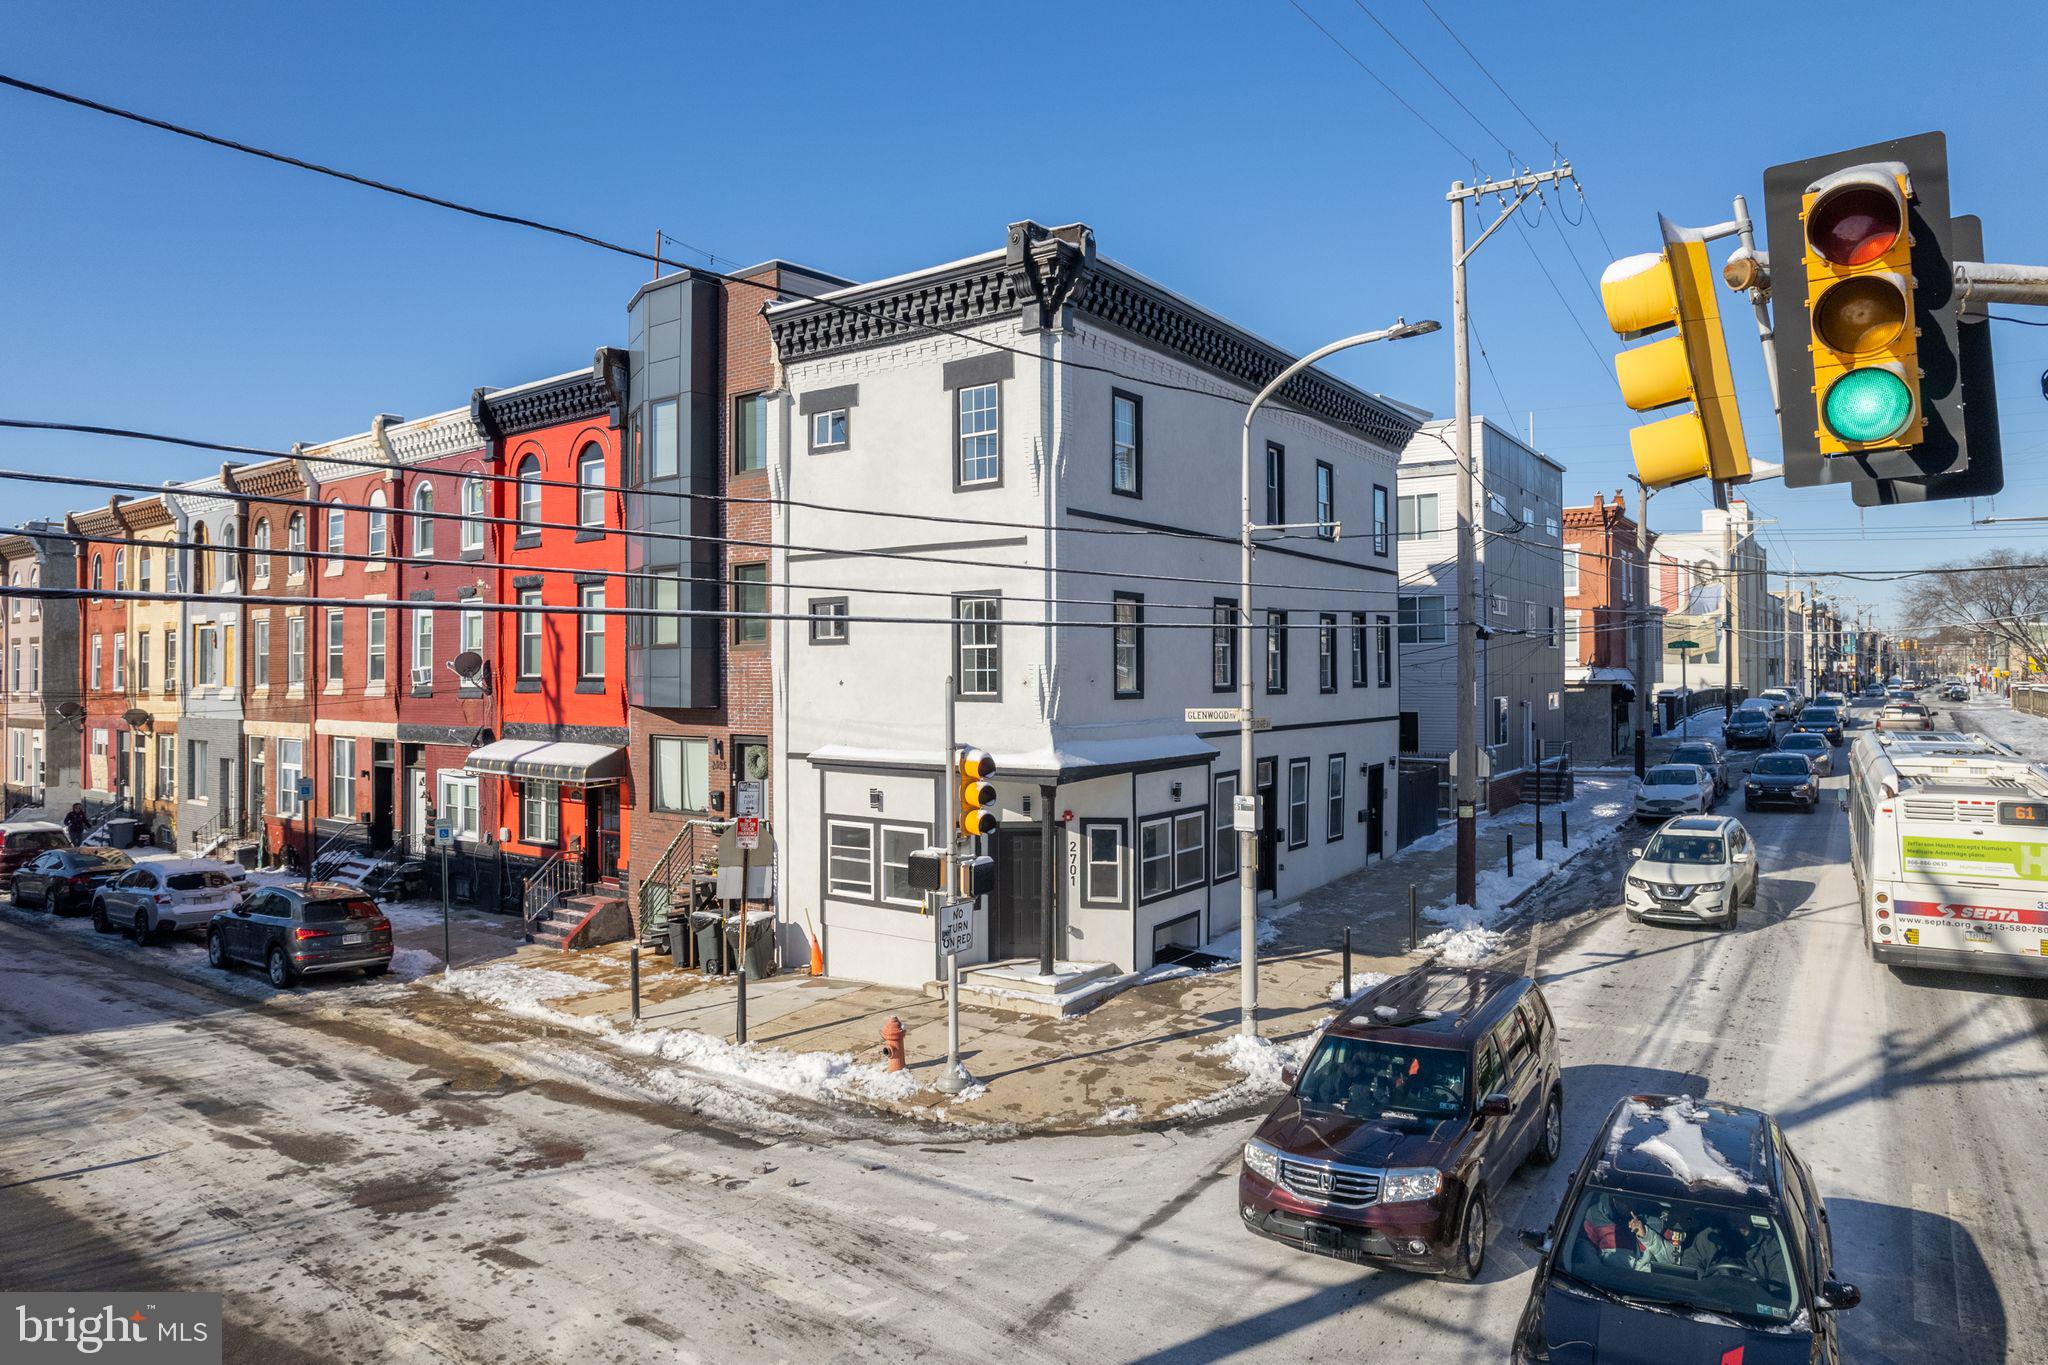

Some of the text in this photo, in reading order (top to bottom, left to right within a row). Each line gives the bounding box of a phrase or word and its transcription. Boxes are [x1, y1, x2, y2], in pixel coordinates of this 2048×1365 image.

[1187, 711, 1229, 720] GLENWOOD
[2015, 806, 2036, 820] 61
[953, 908, 963, 920] NO
[1961, 907, 2019, 922] SEPTA
[948, 920, 968, 933] TURN
[1899, 917, 1971, 929] www.septa.org
[943, 933, 971, 949] ON RED
